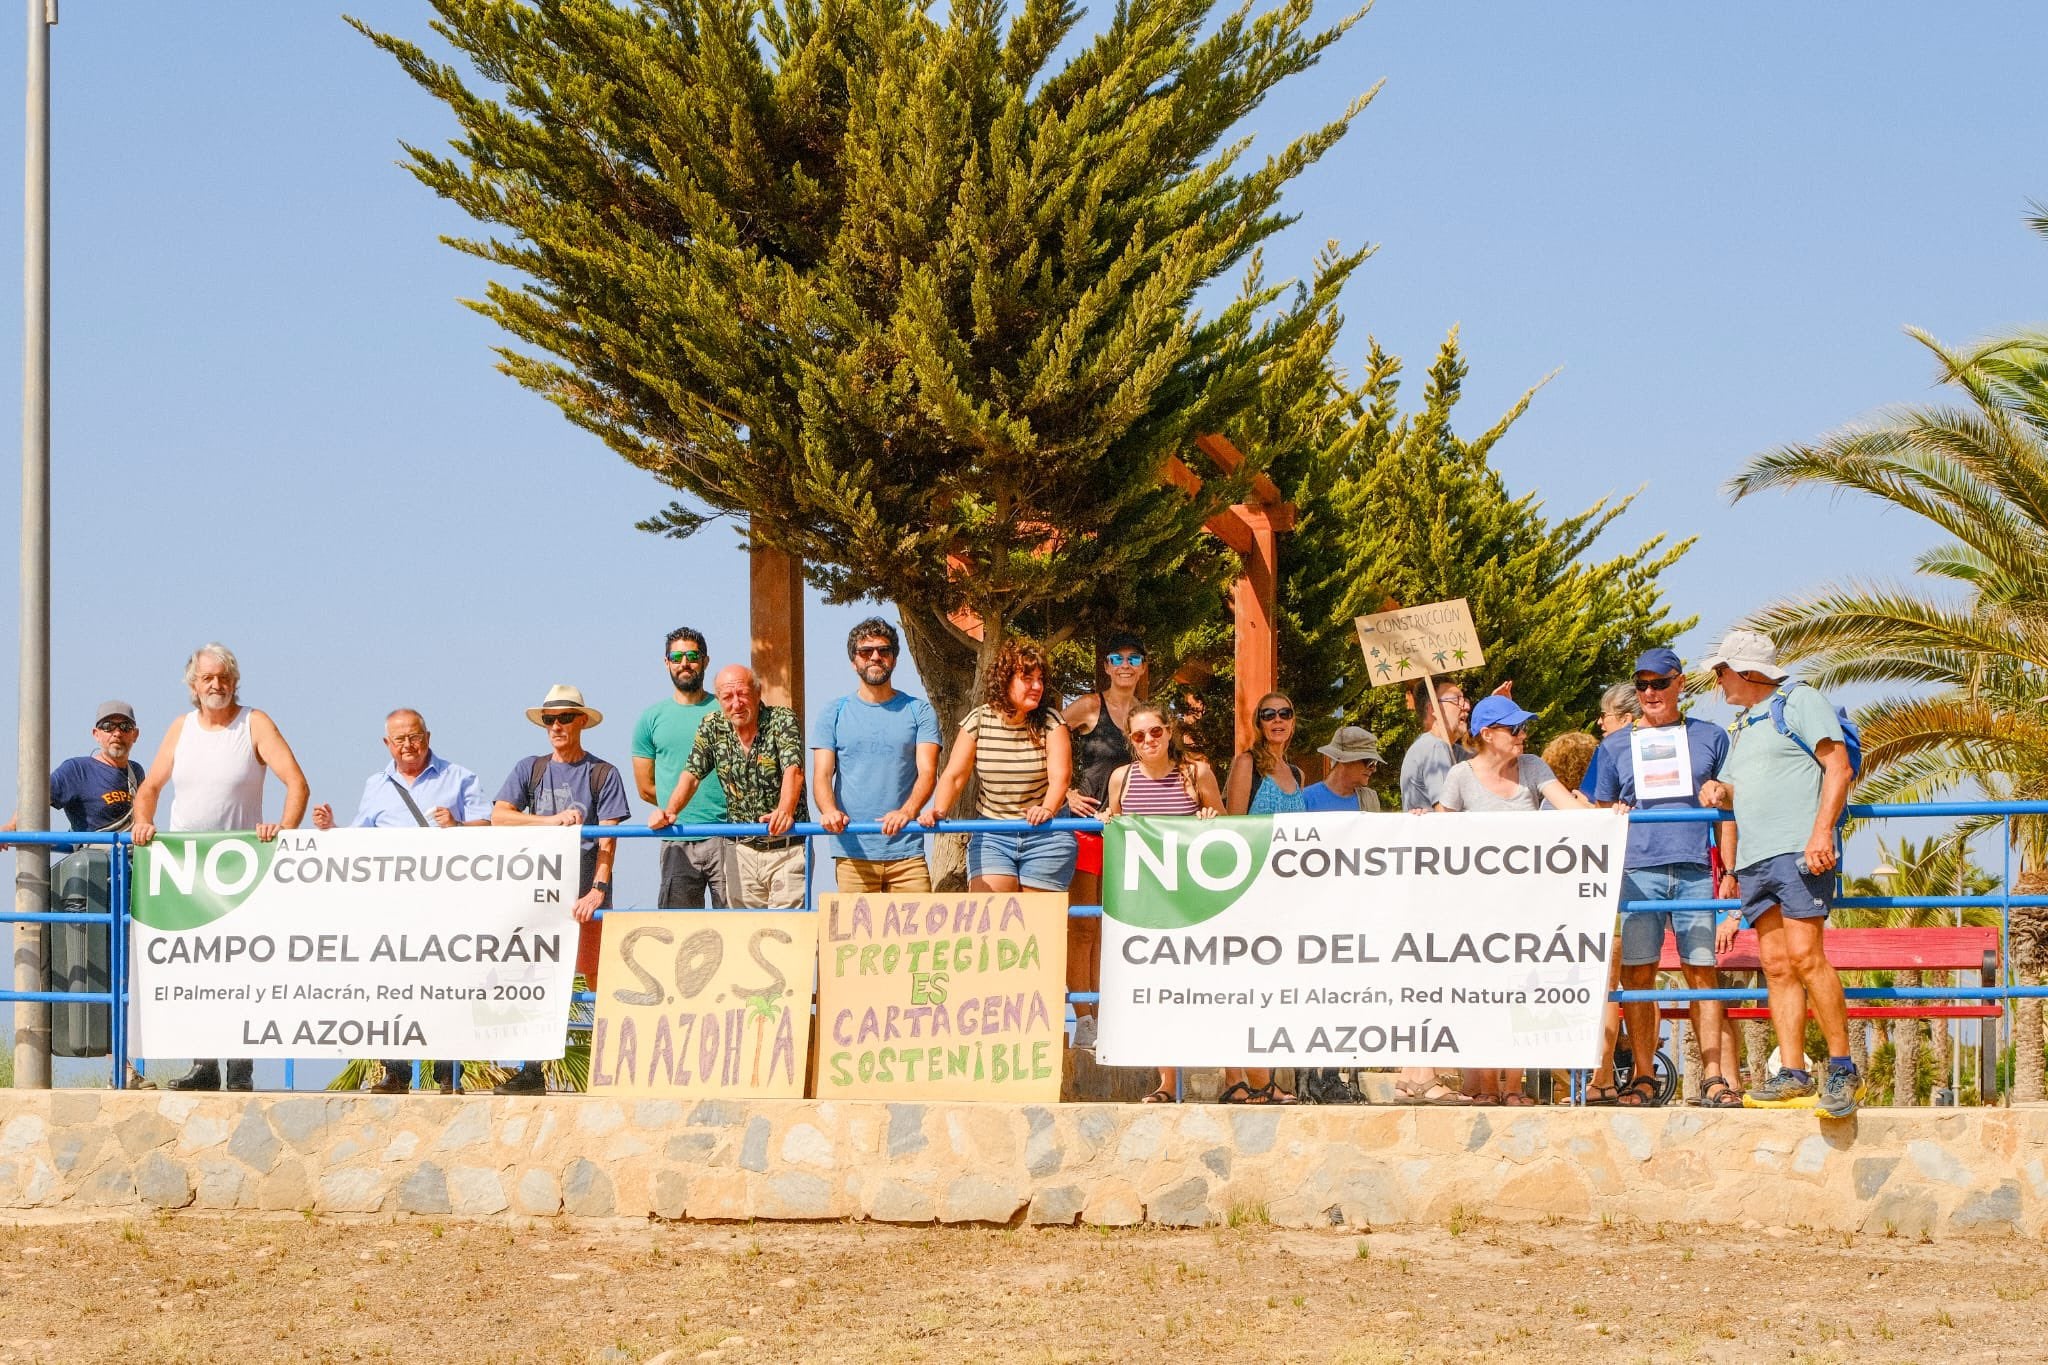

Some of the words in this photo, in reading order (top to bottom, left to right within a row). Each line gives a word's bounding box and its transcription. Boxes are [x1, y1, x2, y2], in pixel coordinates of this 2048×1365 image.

[1382, 629, 1468, 657] VEGETACIÓN
[276, 837, 288, 852] A
[295, 837, 318, 851] LA
[1273, 827, 1288, 842] A
[1294, 827, 1321, 842] LA
[150, 839, 259, 896] NO
[273, 847, 562, 883] CONSTRUCCIÓN
[1124, 829, 1252, 891] NO
[1271, 836, 1609, 878] CONSTRUCCIÓN
[533, 889, 560, 903] EN
[1578, 882, 1607, 898] EN
[828, 896, 873, 942] LA
[882, 895, 1026, 938] AZOHÍA
[147, 935, 275, 965] CAMPO
[288, 934, 360, 962] DEL
[369, 926, 560, 963] ALACRÁN
[835, 933, 1041, 977] PROTEGIDA
[1122, 935, 1282, 965] CAMPO
[1297, 933, 1380, 964] DEL
[1391, 924, 1606, 963] ALACRÁN
[154, 986, 168, 1001] El
[173, 984, 250, 1001] Palmeral
[255, 987, 266, 1003] y
[272, 984, 288, 1000] El
[293, 984, 370, 1002] Alacrán,
[376, 985, 413, 1000] Red
[420, 985, 487, 1001] Natura
[493, 985, 546, 1000] 2000
[911, 972, 949, 1005] ES
[1132, 988, 1151, 1004] El
[1158, 988, 1254, 1005] Palmeral
[1260, 992, 1273, 1008] y
[1280, 988, 1298, 1005] El
[1305, 987, 1393, 1006] Alacrán,
[1400, 987, 1443, 1004] Red
[1451, 987, 1527, 1004] Natura
[1534, 987, 1590, 1004] 2000
[243, 1020, 283, 1045] LA
[292, 1014, 428, 1046] AZOHÍA
[832, 990, 1051, 1047] CARTAGENA
[1247, 1026, 1296, 1053] LA
[1305, 1018, 1460, 1053] AZOHÍA
[593, 1015, 637, 1087] LA
[830, 1041, 1052, 1086] SOSTENIBLE
